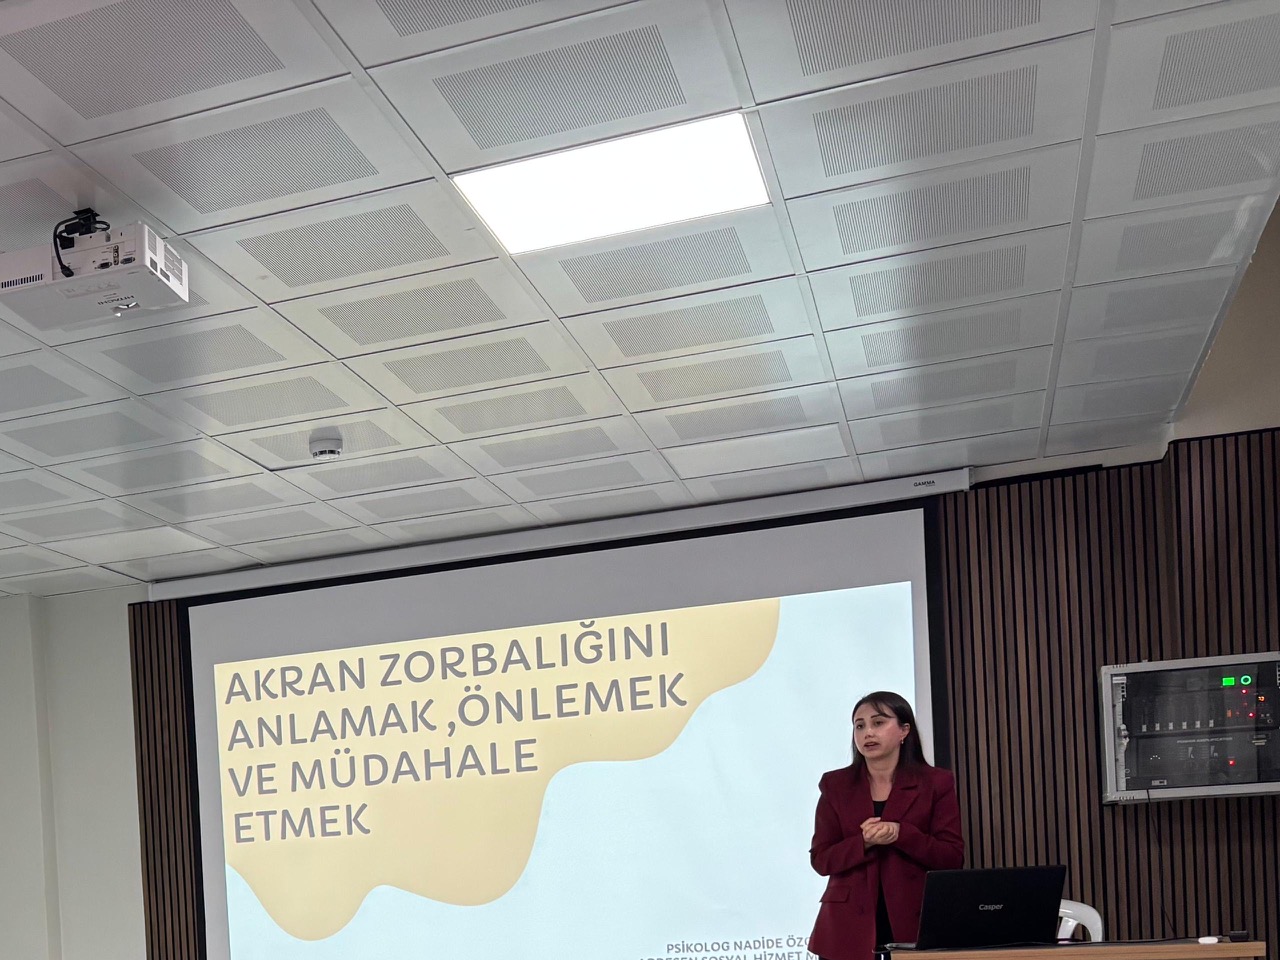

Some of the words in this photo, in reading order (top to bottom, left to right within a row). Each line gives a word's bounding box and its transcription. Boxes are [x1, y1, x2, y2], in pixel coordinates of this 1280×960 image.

[225, 657, 366, 705] AKRAN
[379, 620, 669, 687] ZORBALIĞINI
[227, 698, 437, 752] ANLAMAK
[447, 672, 688, 738] ,ÖNLEMEK
[227, 763, 278, 797] VE
[291, 738, 539, 793] MÜDAHALE
[234, 802, 371, 844] ETMEK
[978, 903, 1004, 911] Casper
[666, 940, 730, 954] PSİKOLOG
[733, 936, 783, 951] NADİDE
